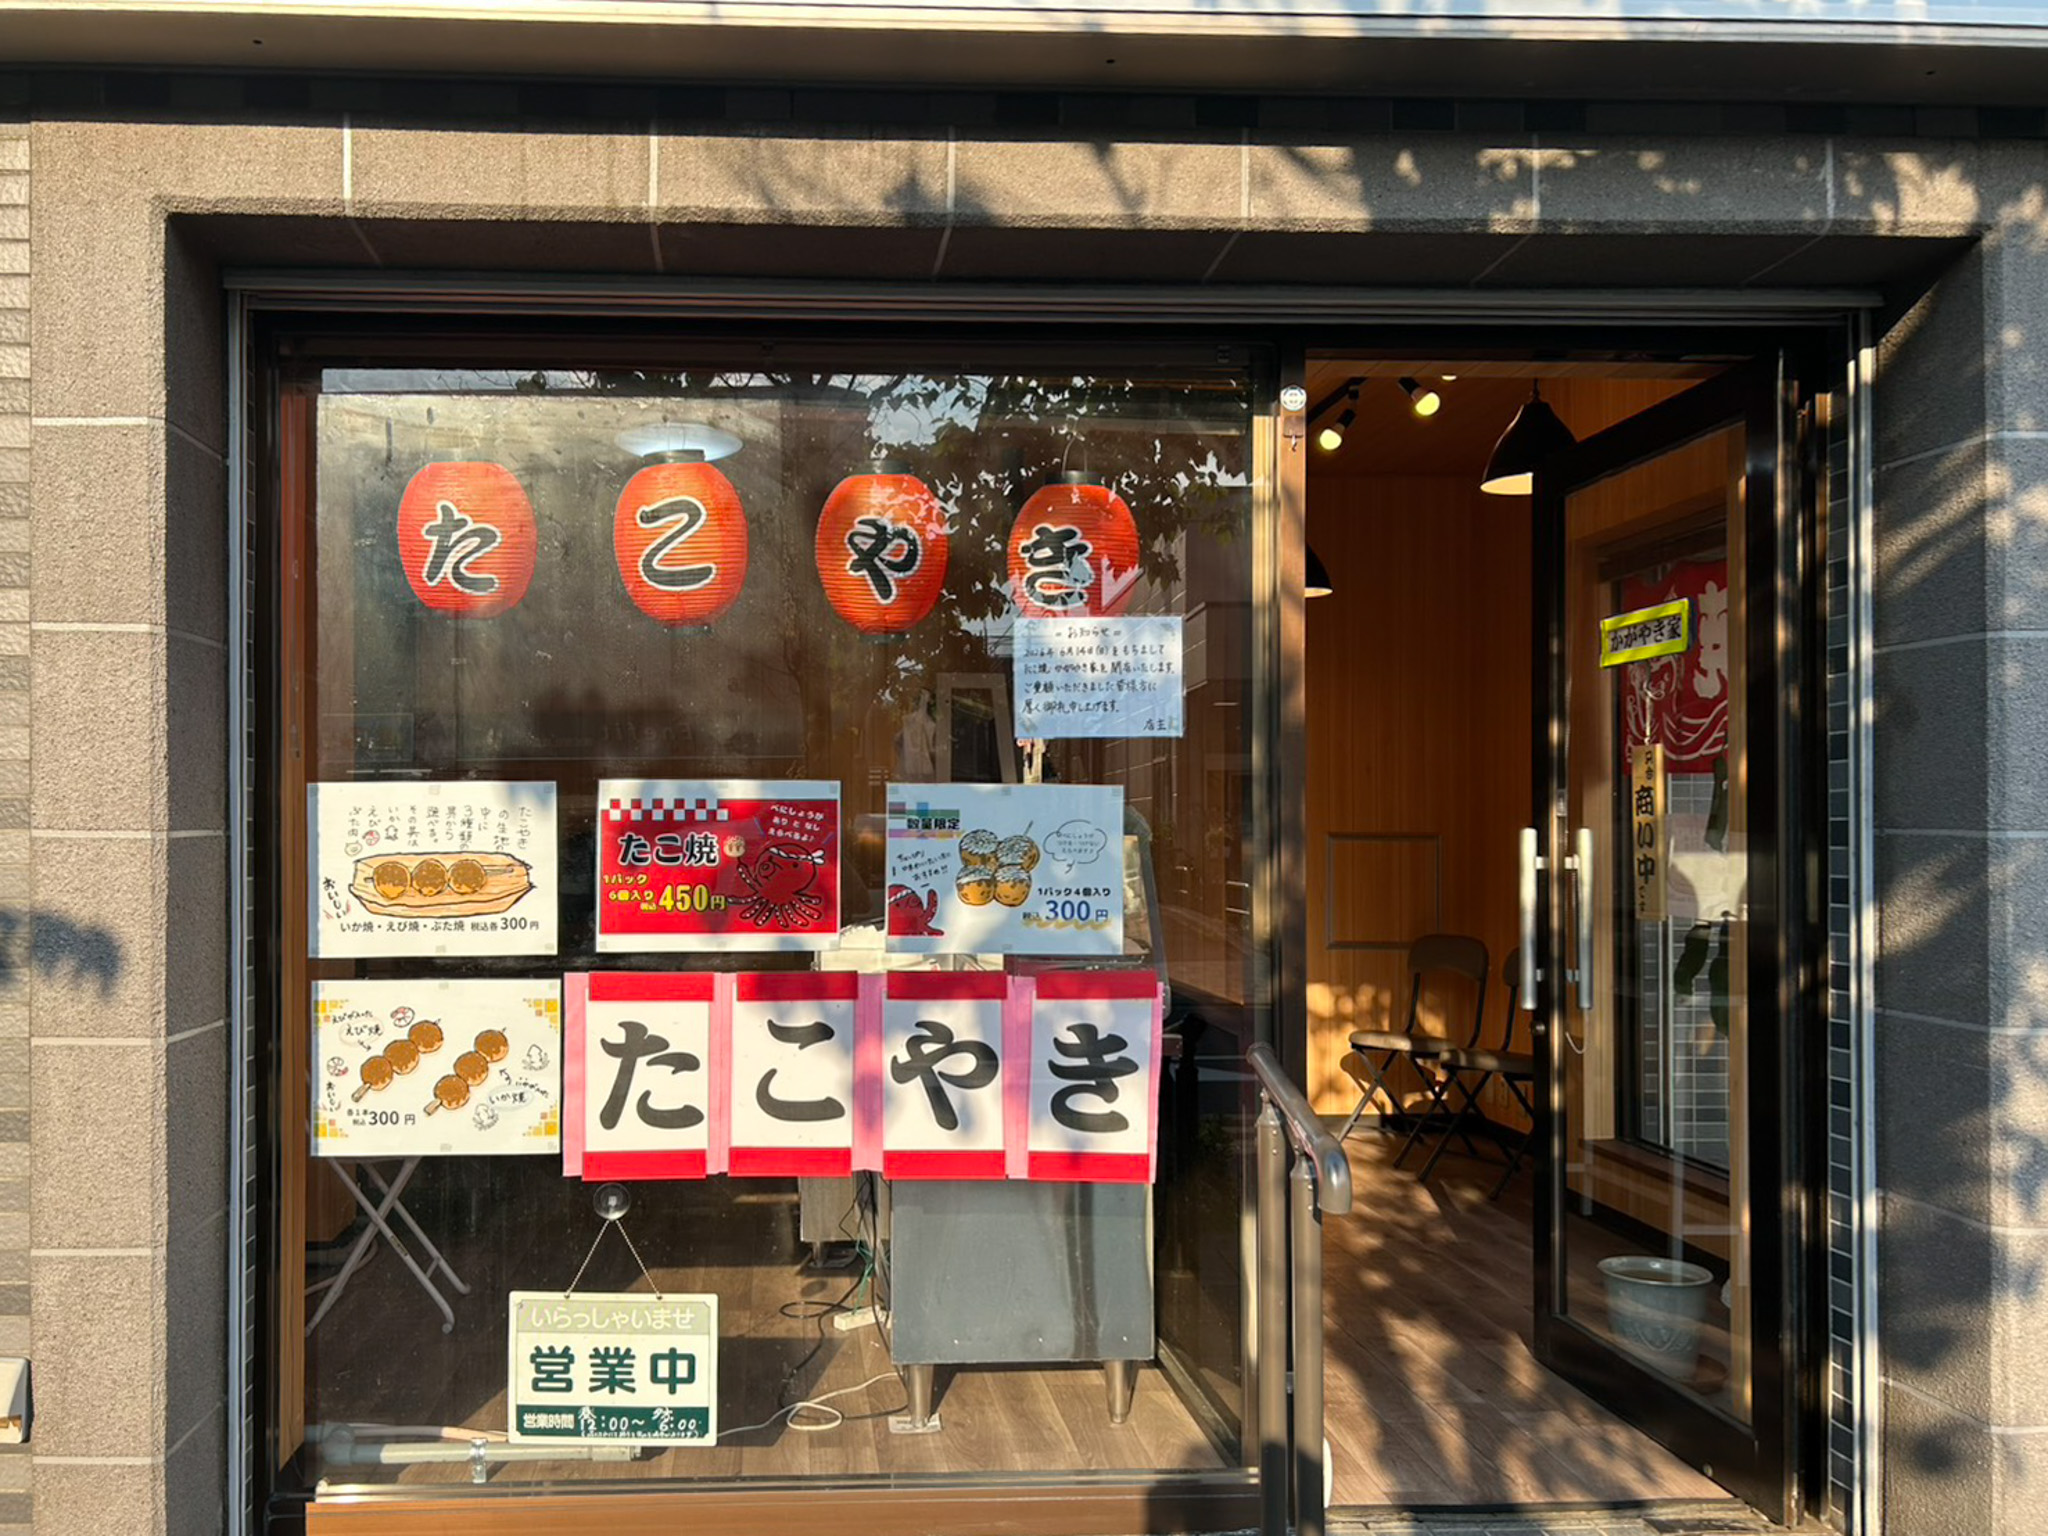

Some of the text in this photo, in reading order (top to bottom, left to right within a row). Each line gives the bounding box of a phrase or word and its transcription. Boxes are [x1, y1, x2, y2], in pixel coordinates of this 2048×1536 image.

[1611, 616, 1681, 652] かがやき家
[1143, 718, 1167, 731] 店主
[368, 805, 381, 827] えび
[388, 806, 401, 822] いか
[478, 806, 491, 831] 中に
[907, 818, 960, 830] 数量限定
[515, 806, 532, 850] たこやき
[618, 832, 720, 866] たこ焼
[600, 1019, 1139, 1132] たこやき
[532, 1305, 695, 1331] いらっしゃいませ
[530, 1345, 697, 1395] 営業中
[523, 1413, 574, 1429] 営業時間
